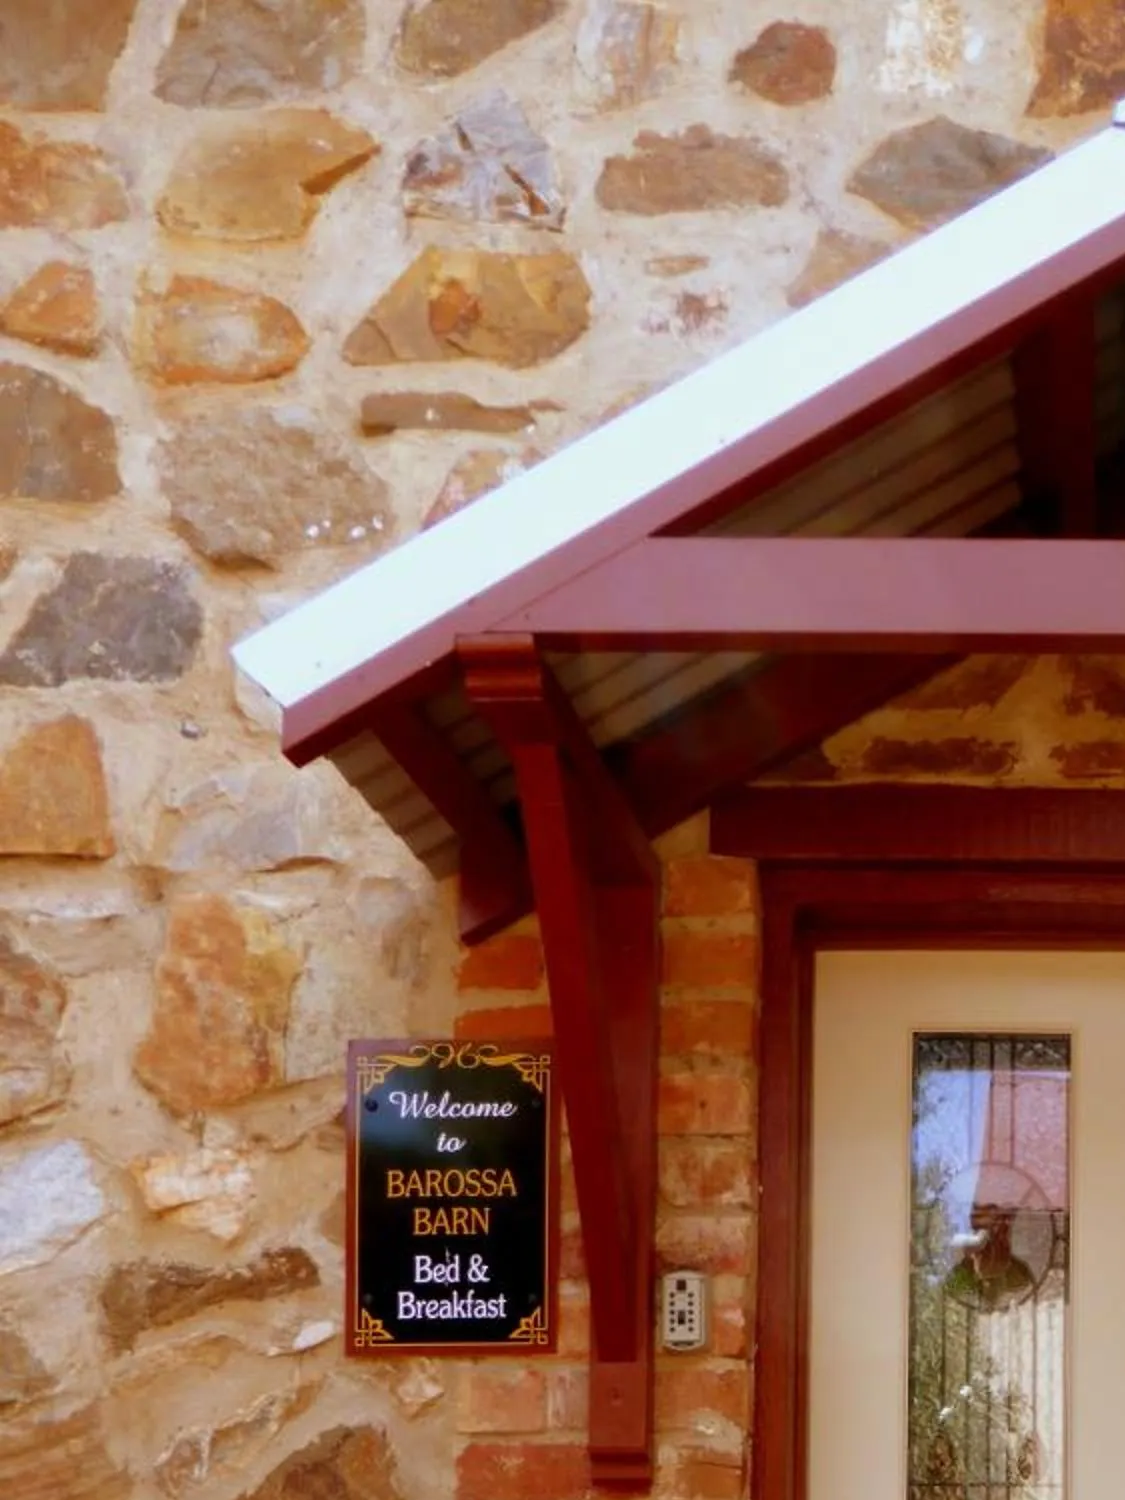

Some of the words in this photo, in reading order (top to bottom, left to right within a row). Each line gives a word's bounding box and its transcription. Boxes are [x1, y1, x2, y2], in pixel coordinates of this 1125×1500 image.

[389, 1091, 518, 1119] Welcome
[436, 1131, 467, 1153] to
[387, 1169, 518, 1198] BAROSSA
[413, 1207, 491, 1236] BARN
[414, 1253, 461, 1284] Bed
[467, 1253, 491, 1283] &
[397, 1290, 507, 1320] Breakfast
